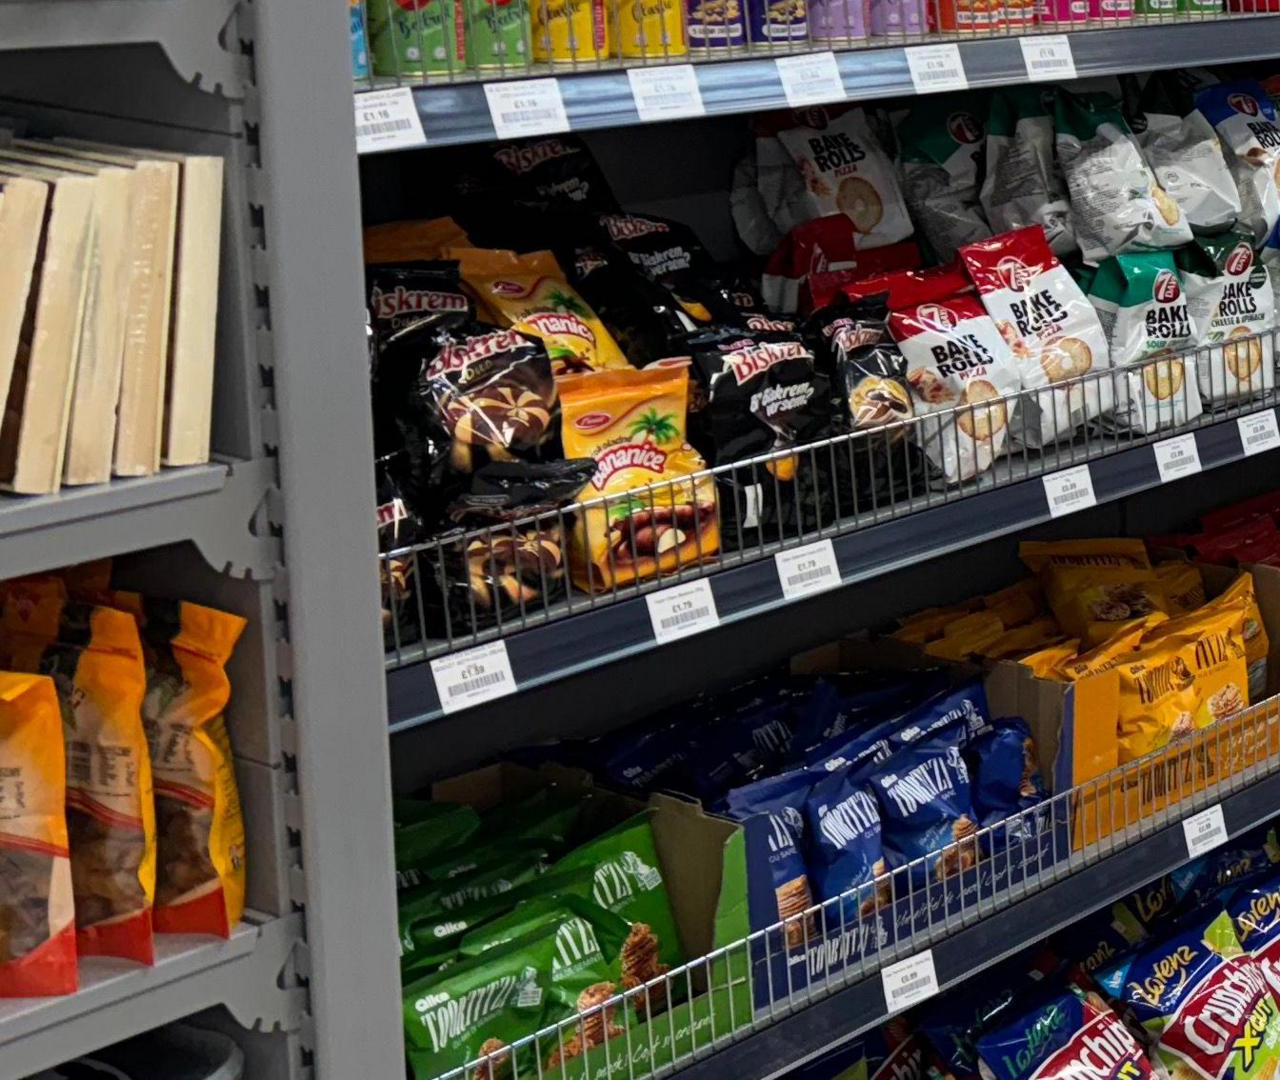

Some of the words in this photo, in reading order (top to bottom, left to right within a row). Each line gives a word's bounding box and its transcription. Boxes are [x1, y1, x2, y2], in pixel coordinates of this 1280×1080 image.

[1246, 120, 1279, 141] BAKE
[808, 131, 854, 156] BAKE
[813, 143, 867, 173] ROLLS
[834, 163, 858, 178] PIZZA
[371, 285, 468, 320] iskrem
[1008, 287, 1057, 322] BAKE
[1219, 296, 1257, 317] ROLLS
[930, 332, 983, 364] BAKE
[959, 368, 988, 381] PIZZA
[1128, 945, 1199, 1007] Lorenz
[414, 991, 451, 1013] alka
